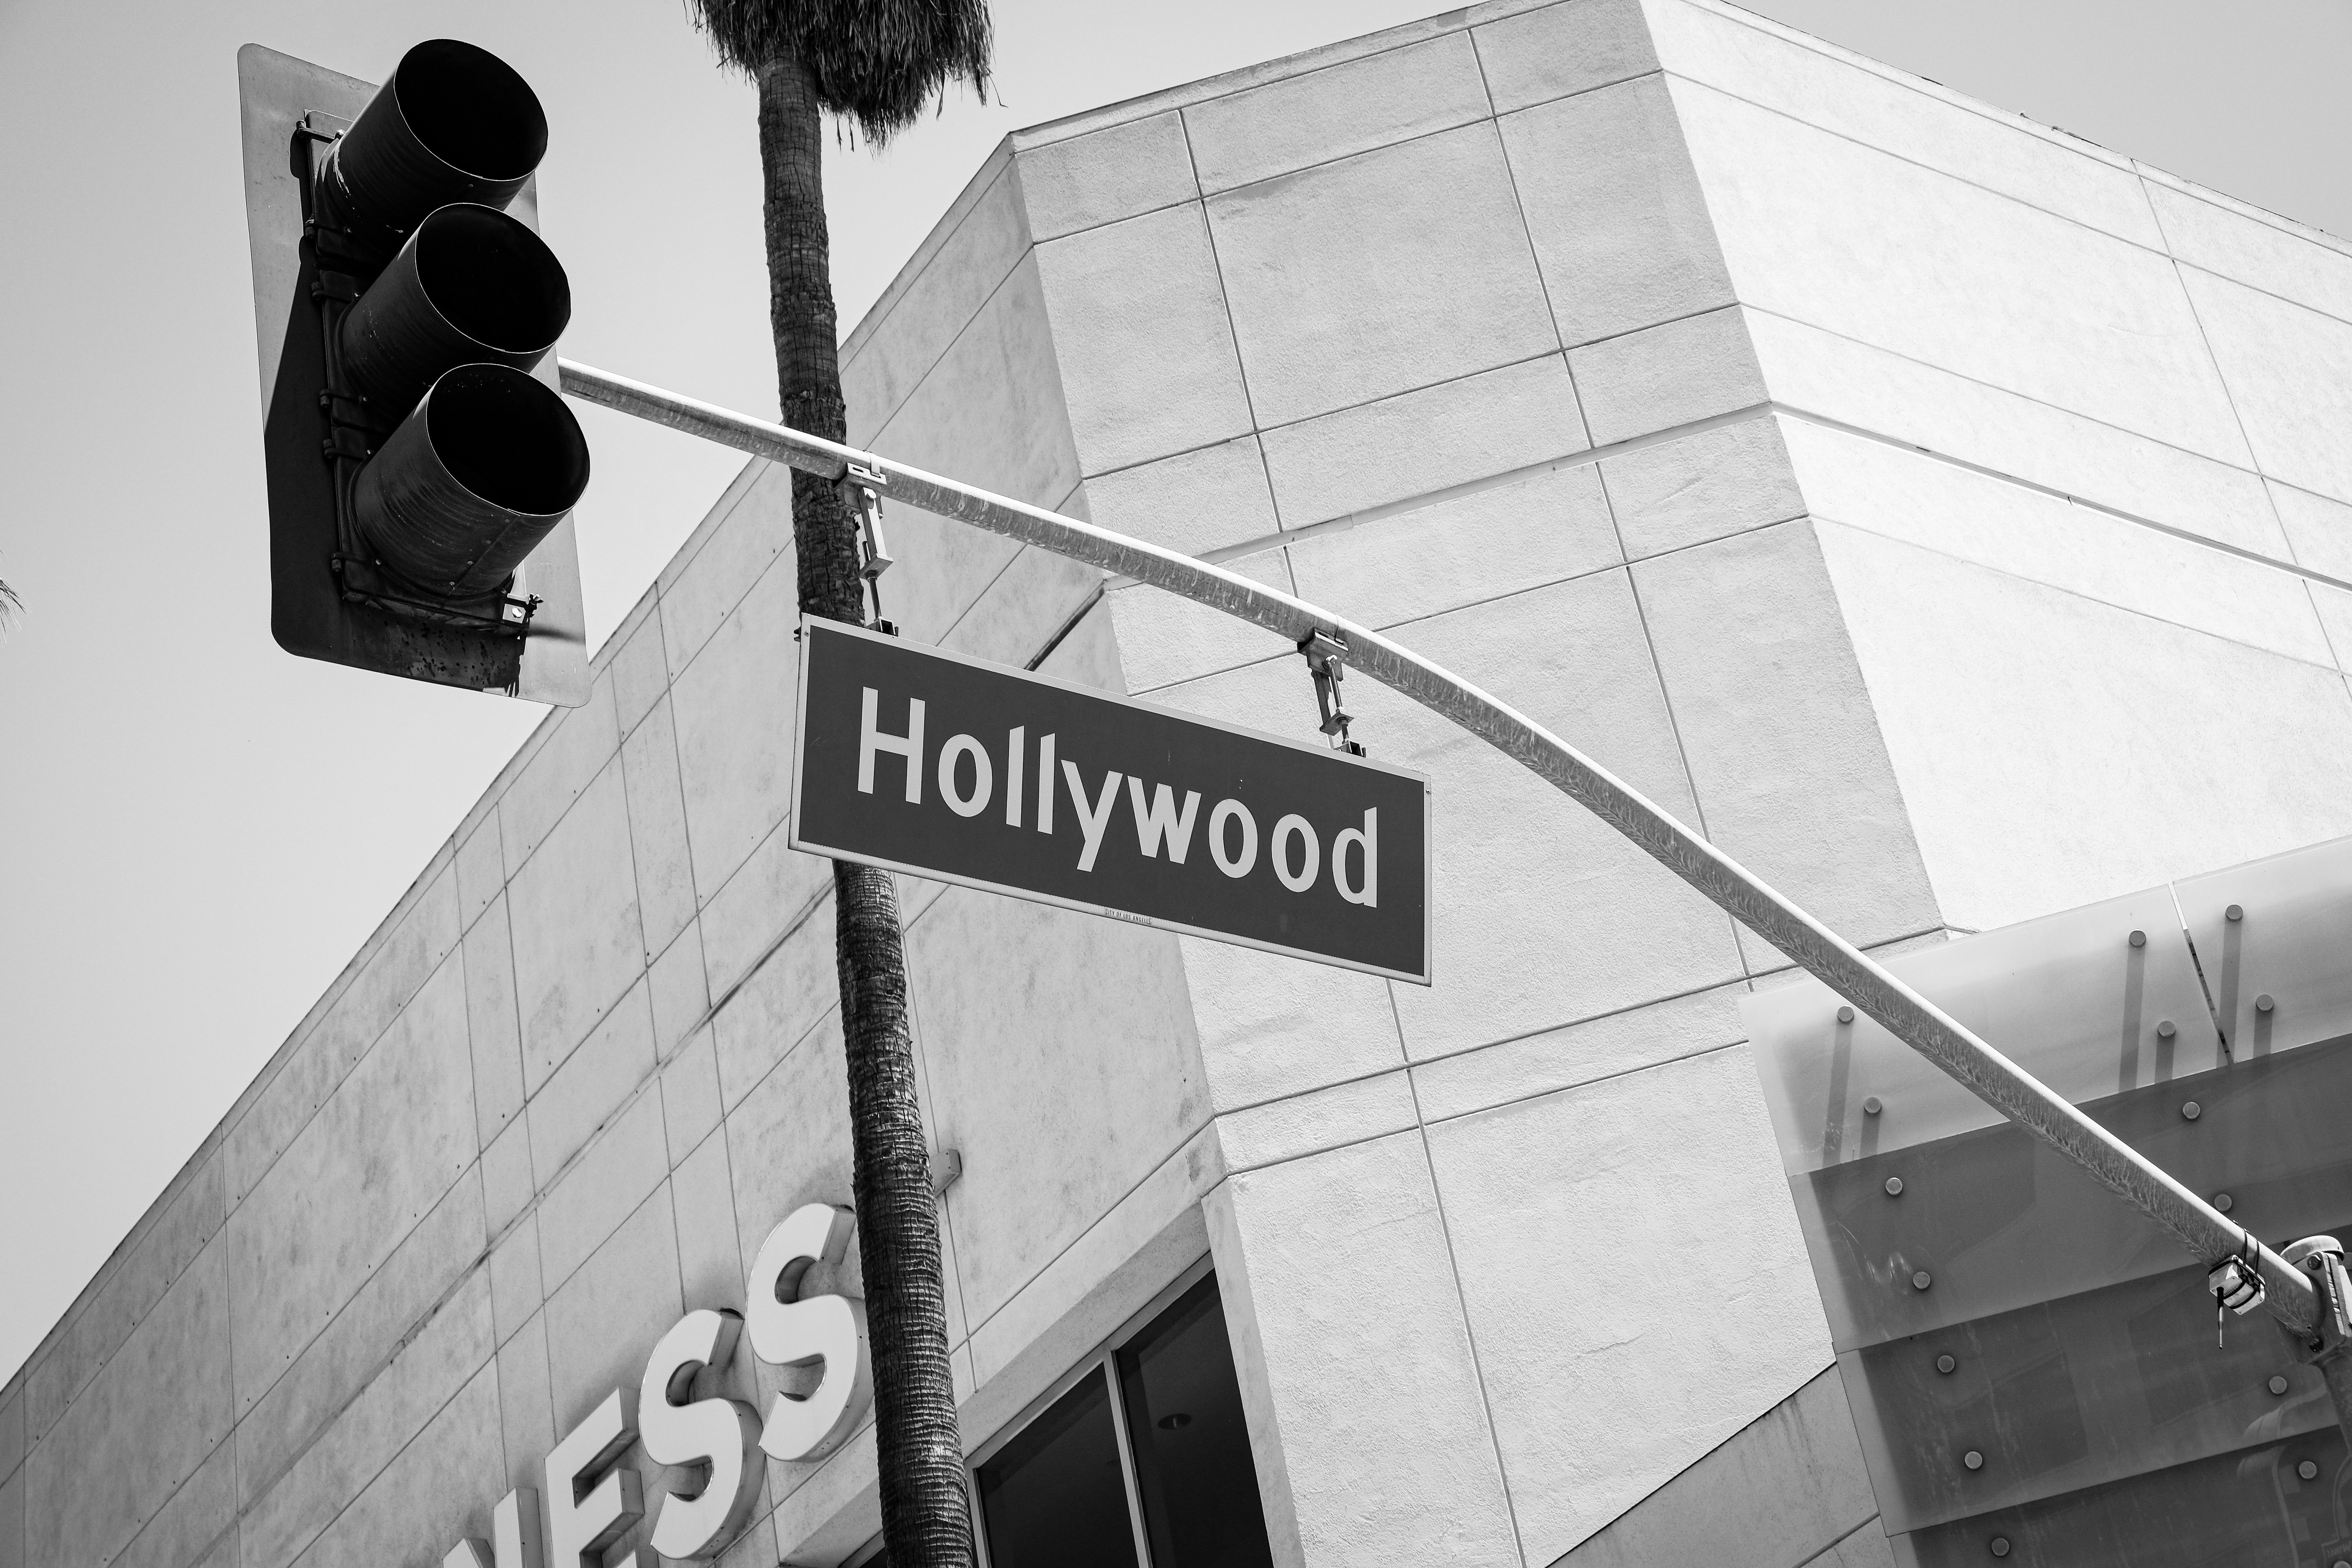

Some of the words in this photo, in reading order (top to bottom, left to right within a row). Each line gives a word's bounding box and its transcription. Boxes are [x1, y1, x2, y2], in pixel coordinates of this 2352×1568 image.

[858, 686, 1378, 909] Hollywood
[1132, 916, 1151, 925] ANGELES
[442, 1203, 866, 1568] ESS
